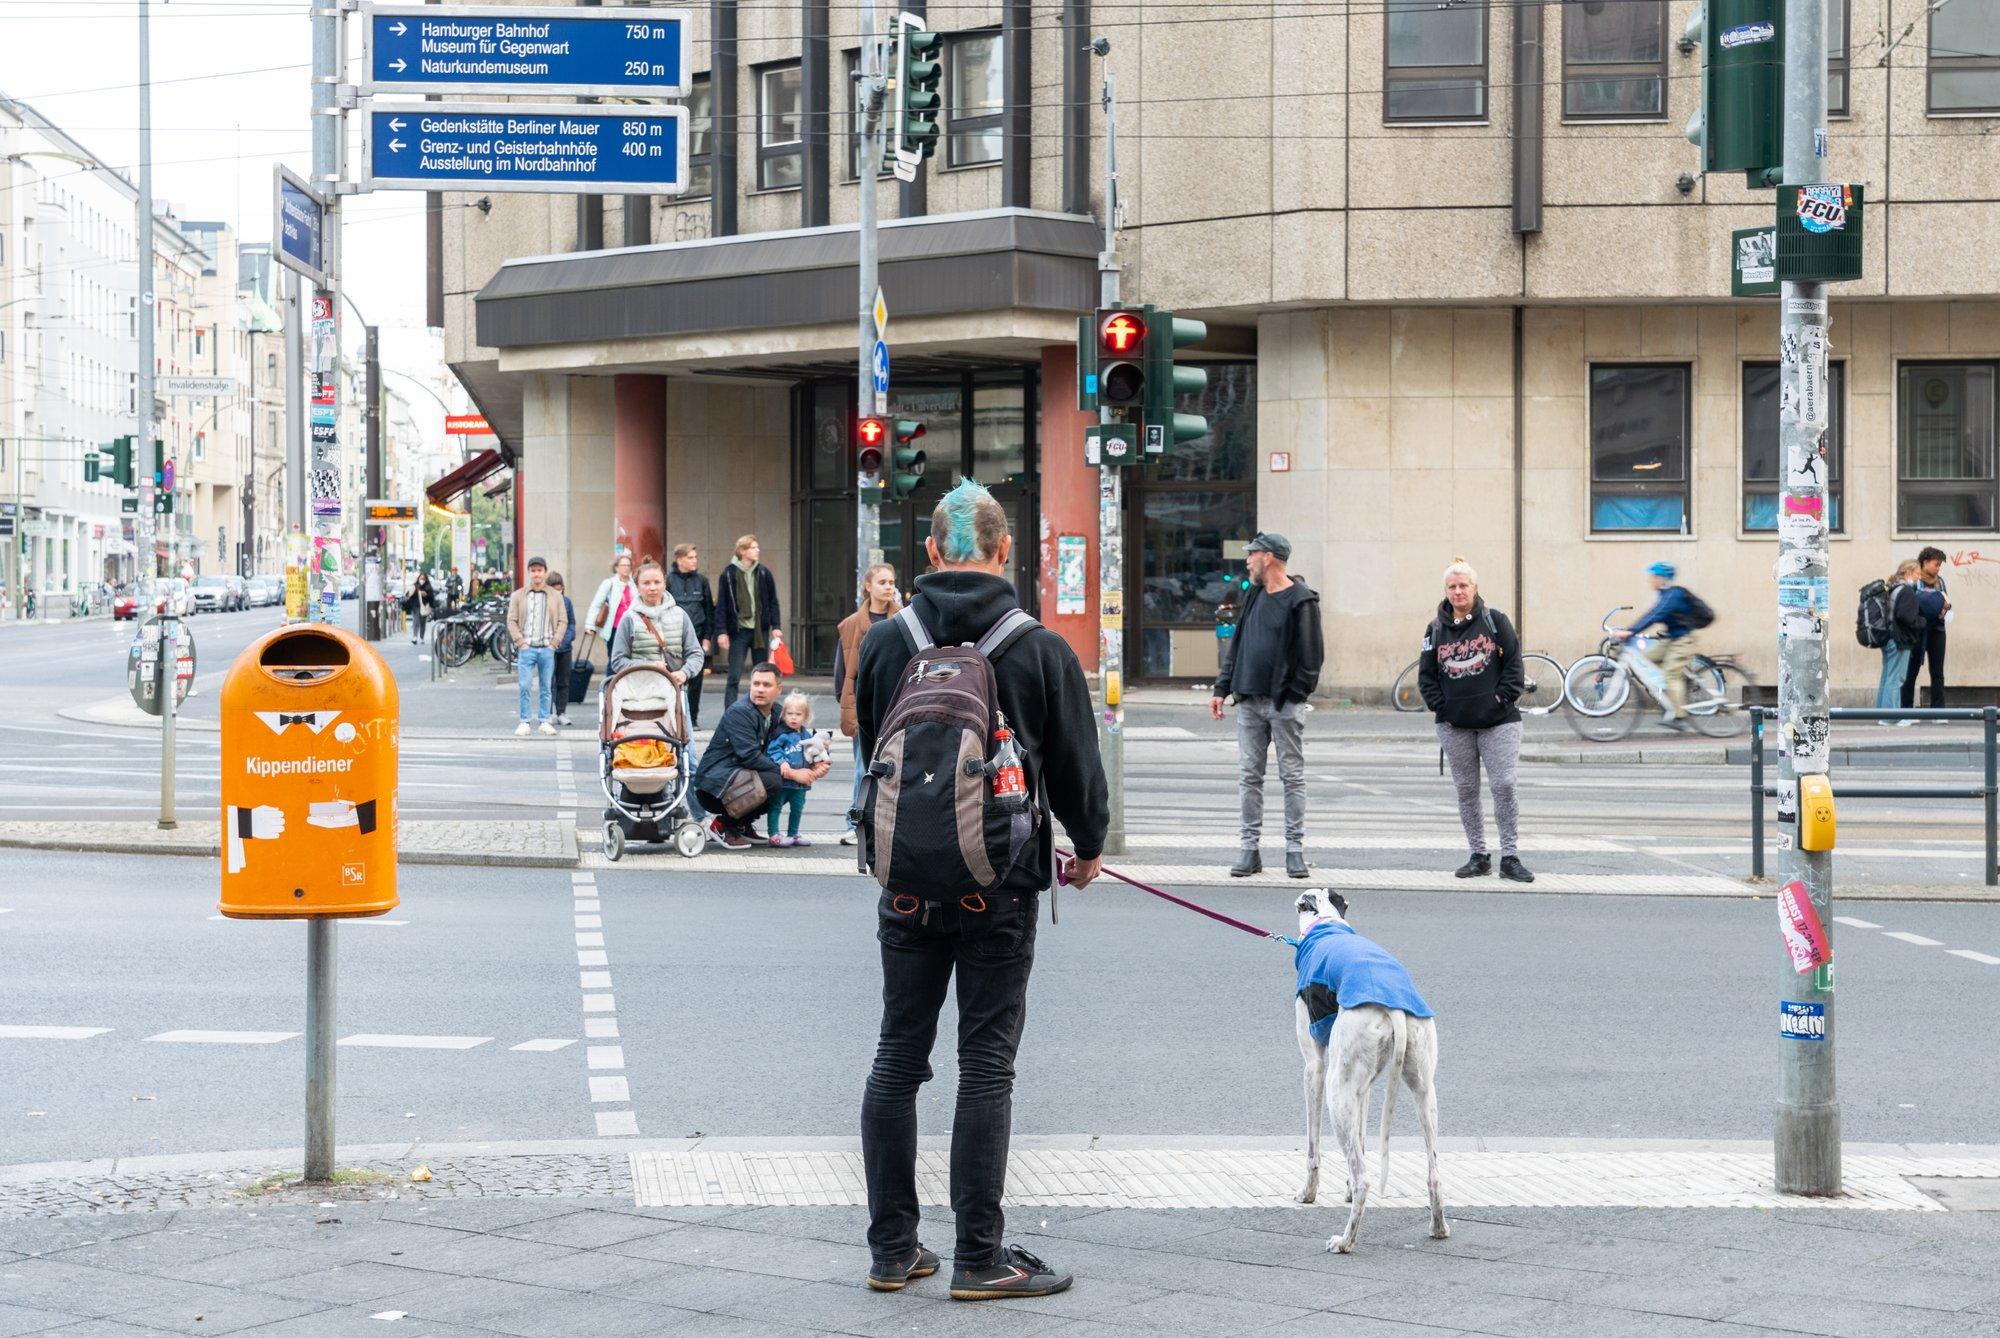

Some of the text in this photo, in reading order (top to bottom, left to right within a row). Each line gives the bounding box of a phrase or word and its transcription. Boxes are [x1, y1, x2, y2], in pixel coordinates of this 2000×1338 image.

[422, 23, 549, 40] Hamburger Bahnhof
[626, 25, 665, 39] 750 m
[422, 39, 570, 56] Museum für Gegenwart
[422, 59, 549, 75] Naturkundemuseum
[625, 62, 665, 76] 250 m
[421, 118, 600, 136] Gedenkstätte Berliner Mauer
[623, 122, 662, 136] 850 m
[421, 140, 598, 156] Grenz- und Geisterbahnhöfe
[622, 143, 662, 157] 400 m
[420, 156, 597, 173] Ausstellung im Nordbahnhof
[1801, 199, 1841, 221] FCU
[164, 380, 230, 392] Invalidenstraße
[314, 426, 335, 438] ESFF
[247, 756, 353, 777] Kippendiener
[1784, 888, 1803, 920] HERBST
